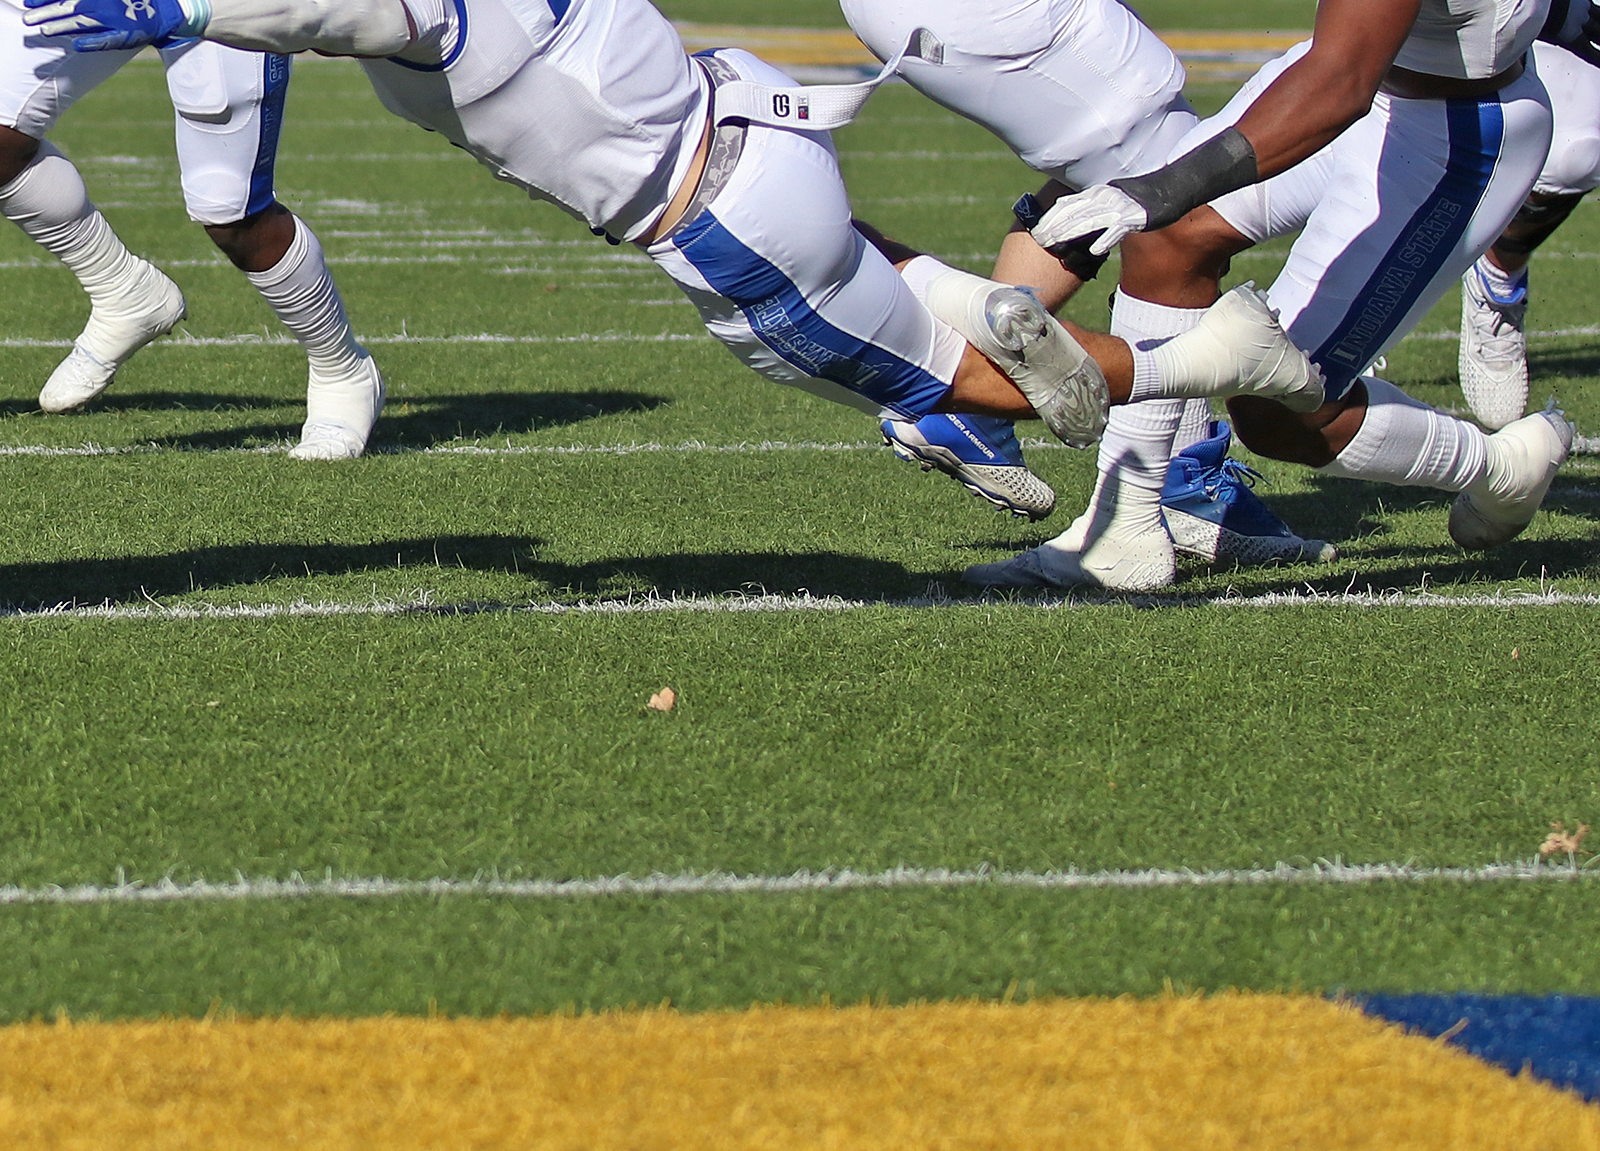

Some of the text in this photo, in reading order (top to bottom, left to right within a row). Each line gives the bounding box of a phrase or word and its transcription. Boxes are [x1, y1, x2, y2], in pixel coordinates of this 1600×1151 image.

[1326, 197, 1462, 370] INDIANA STATE
[945, 413, 995, 460] DER ARMOUR
